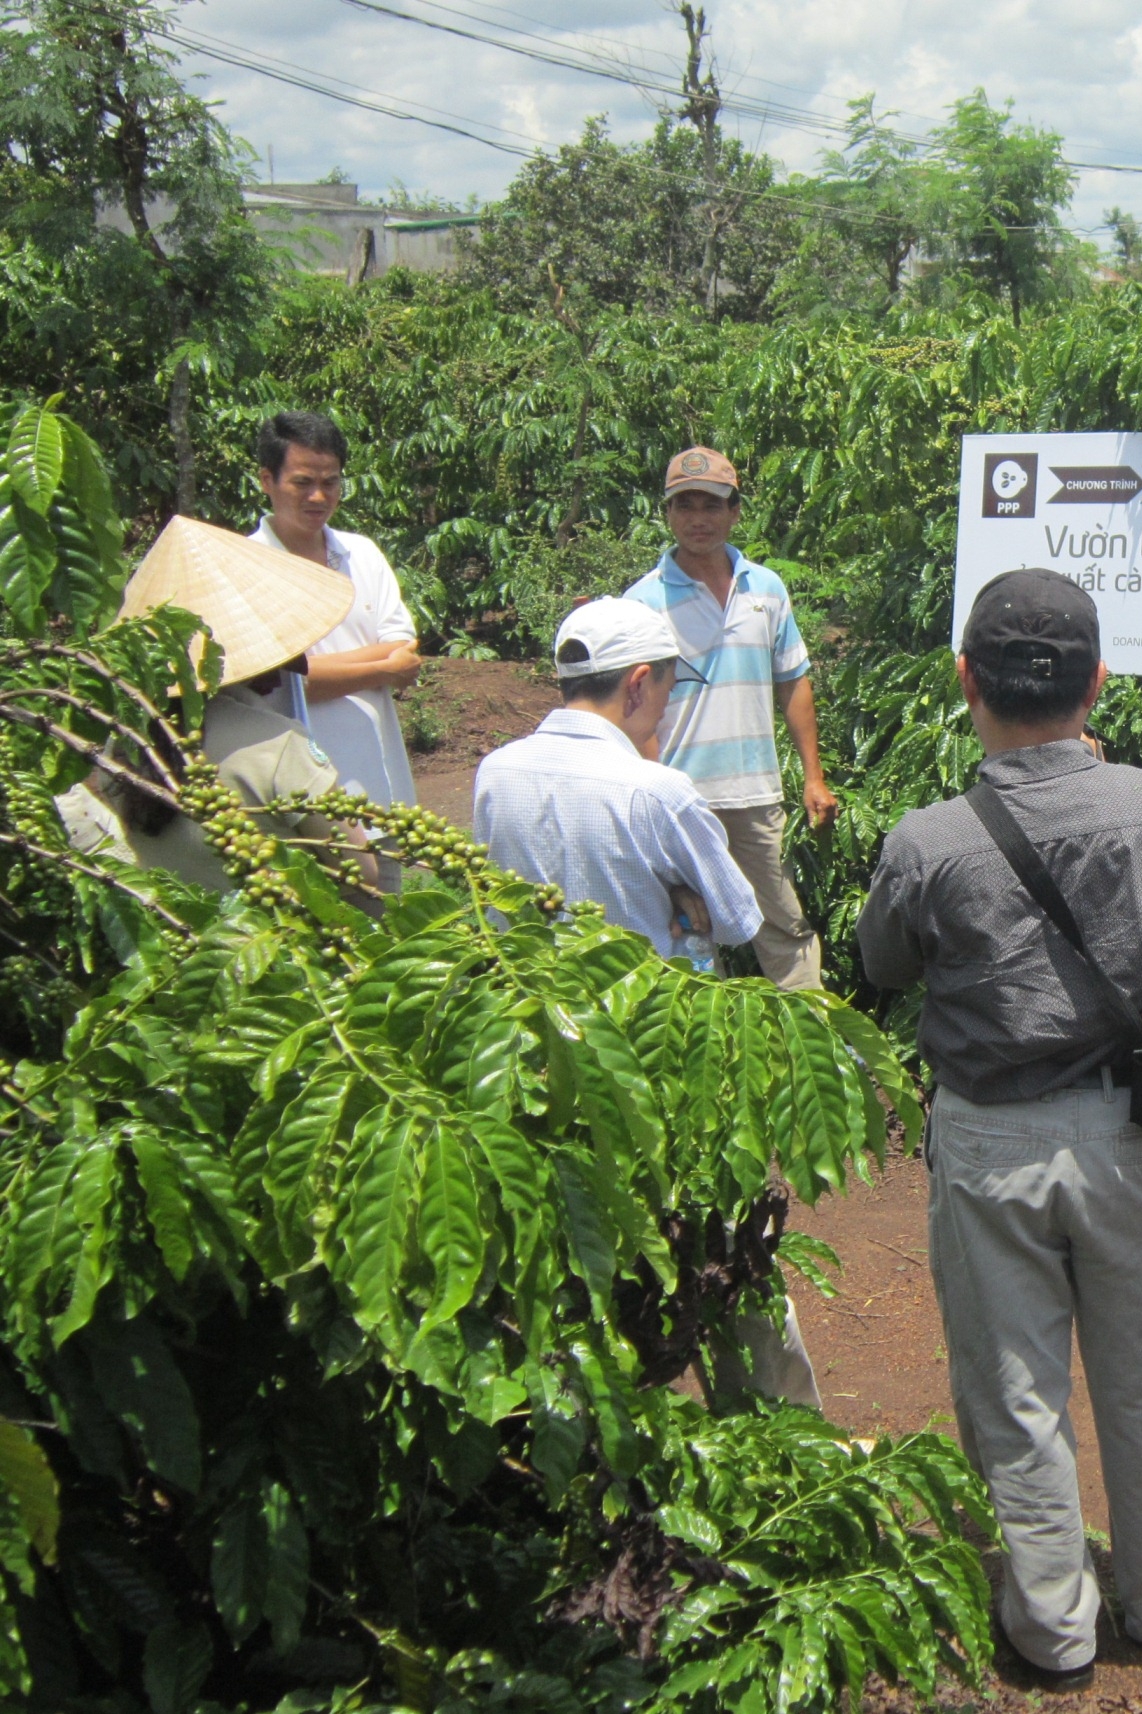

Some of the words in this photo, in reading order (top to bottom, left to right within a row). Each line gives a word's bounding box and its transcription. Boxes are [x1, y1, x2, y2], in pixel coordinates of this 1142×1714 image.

[1066, 480, 1107, 490] CHƯƠNG
[1110, 478, 1138, 490] TRÌNH
[997, 502, 1020, 514] PPP
[1044, 522, 1127, 559] Vườn
[1061, 562, 1106, 592] uất
[1114, 567, 1142, 592] cà
